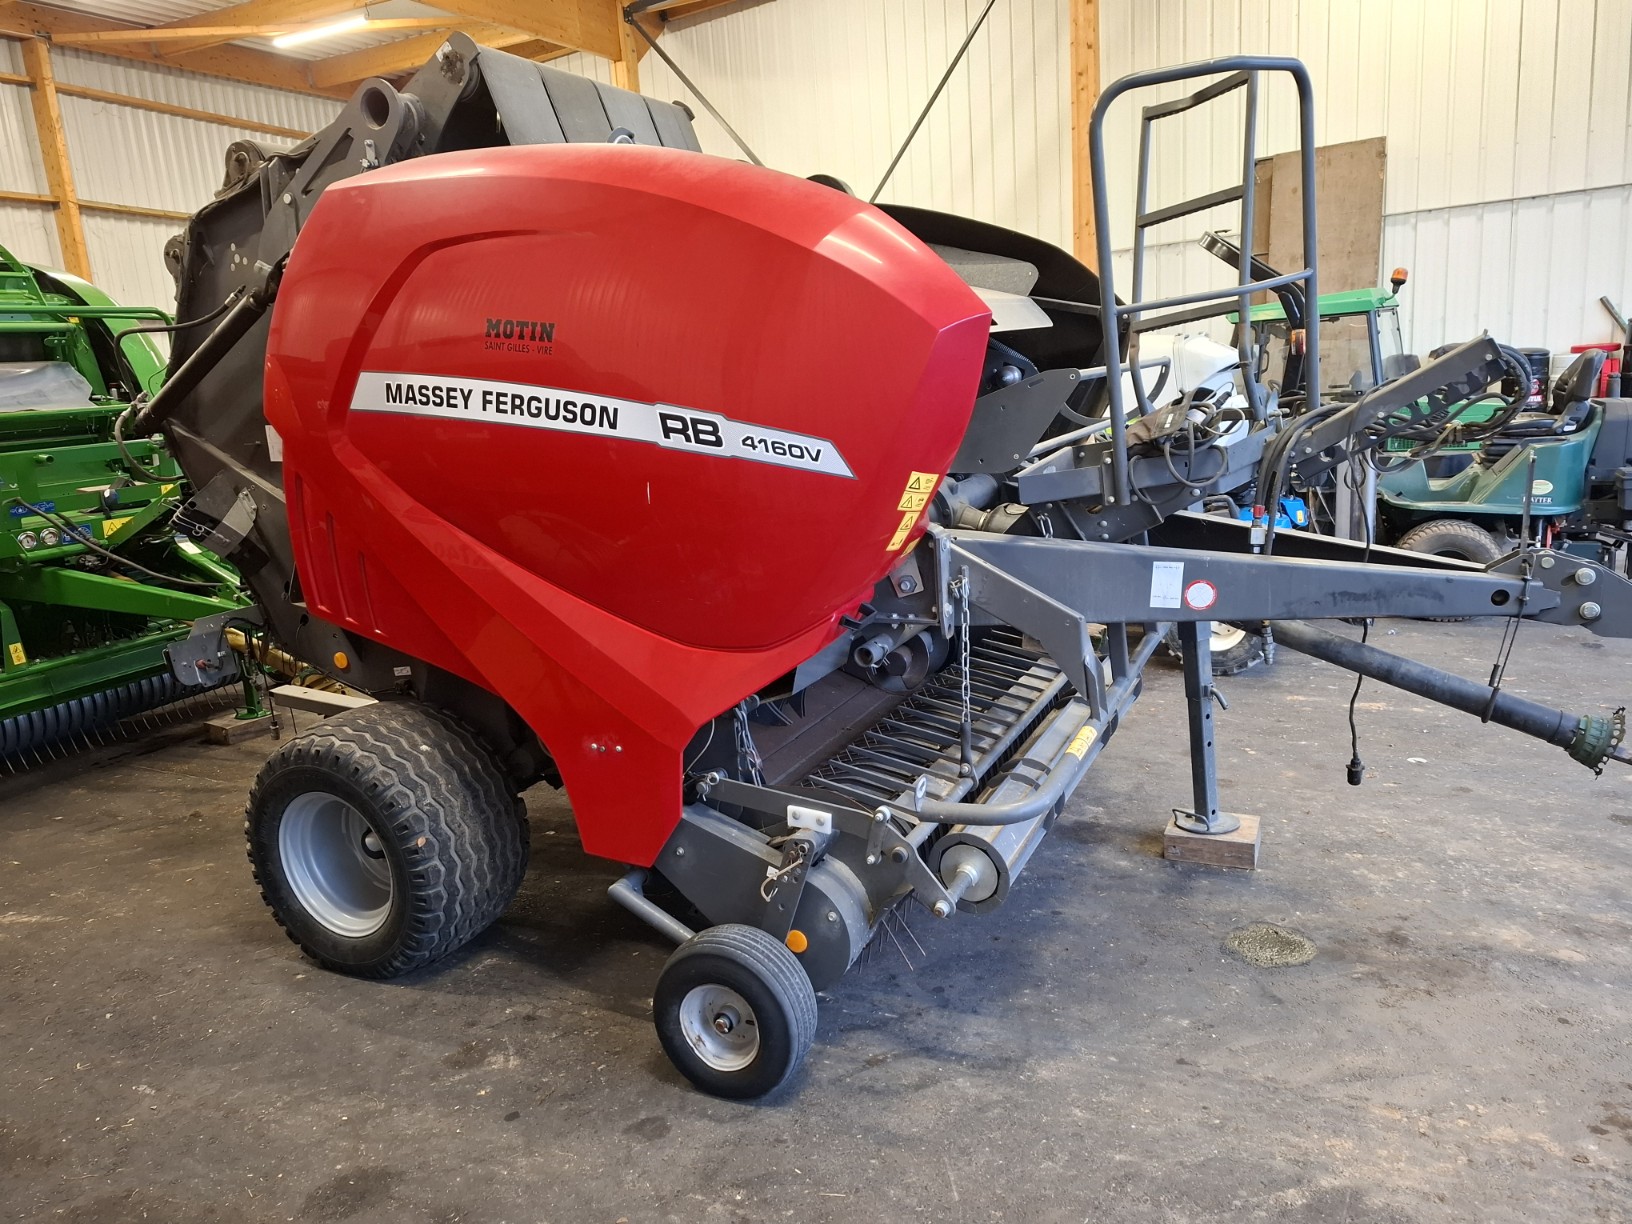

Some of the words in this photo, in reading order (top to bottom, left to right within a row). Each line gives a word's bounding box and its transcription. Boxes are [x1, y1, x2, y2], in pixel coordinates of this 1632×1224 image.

[485, 318, 555, 343] MOTIN
[484, 341, 505, 352] SAINT
[507, 342, 530, 354] GILLES
[537, 345, 553, 356] VIRE
[385, 382, 473, 410] MASSEY
[482, 390, 619, 430] FERGUSON
[658, 412, 724, 448] RB
[741, 435, 822, 463] 4160V
